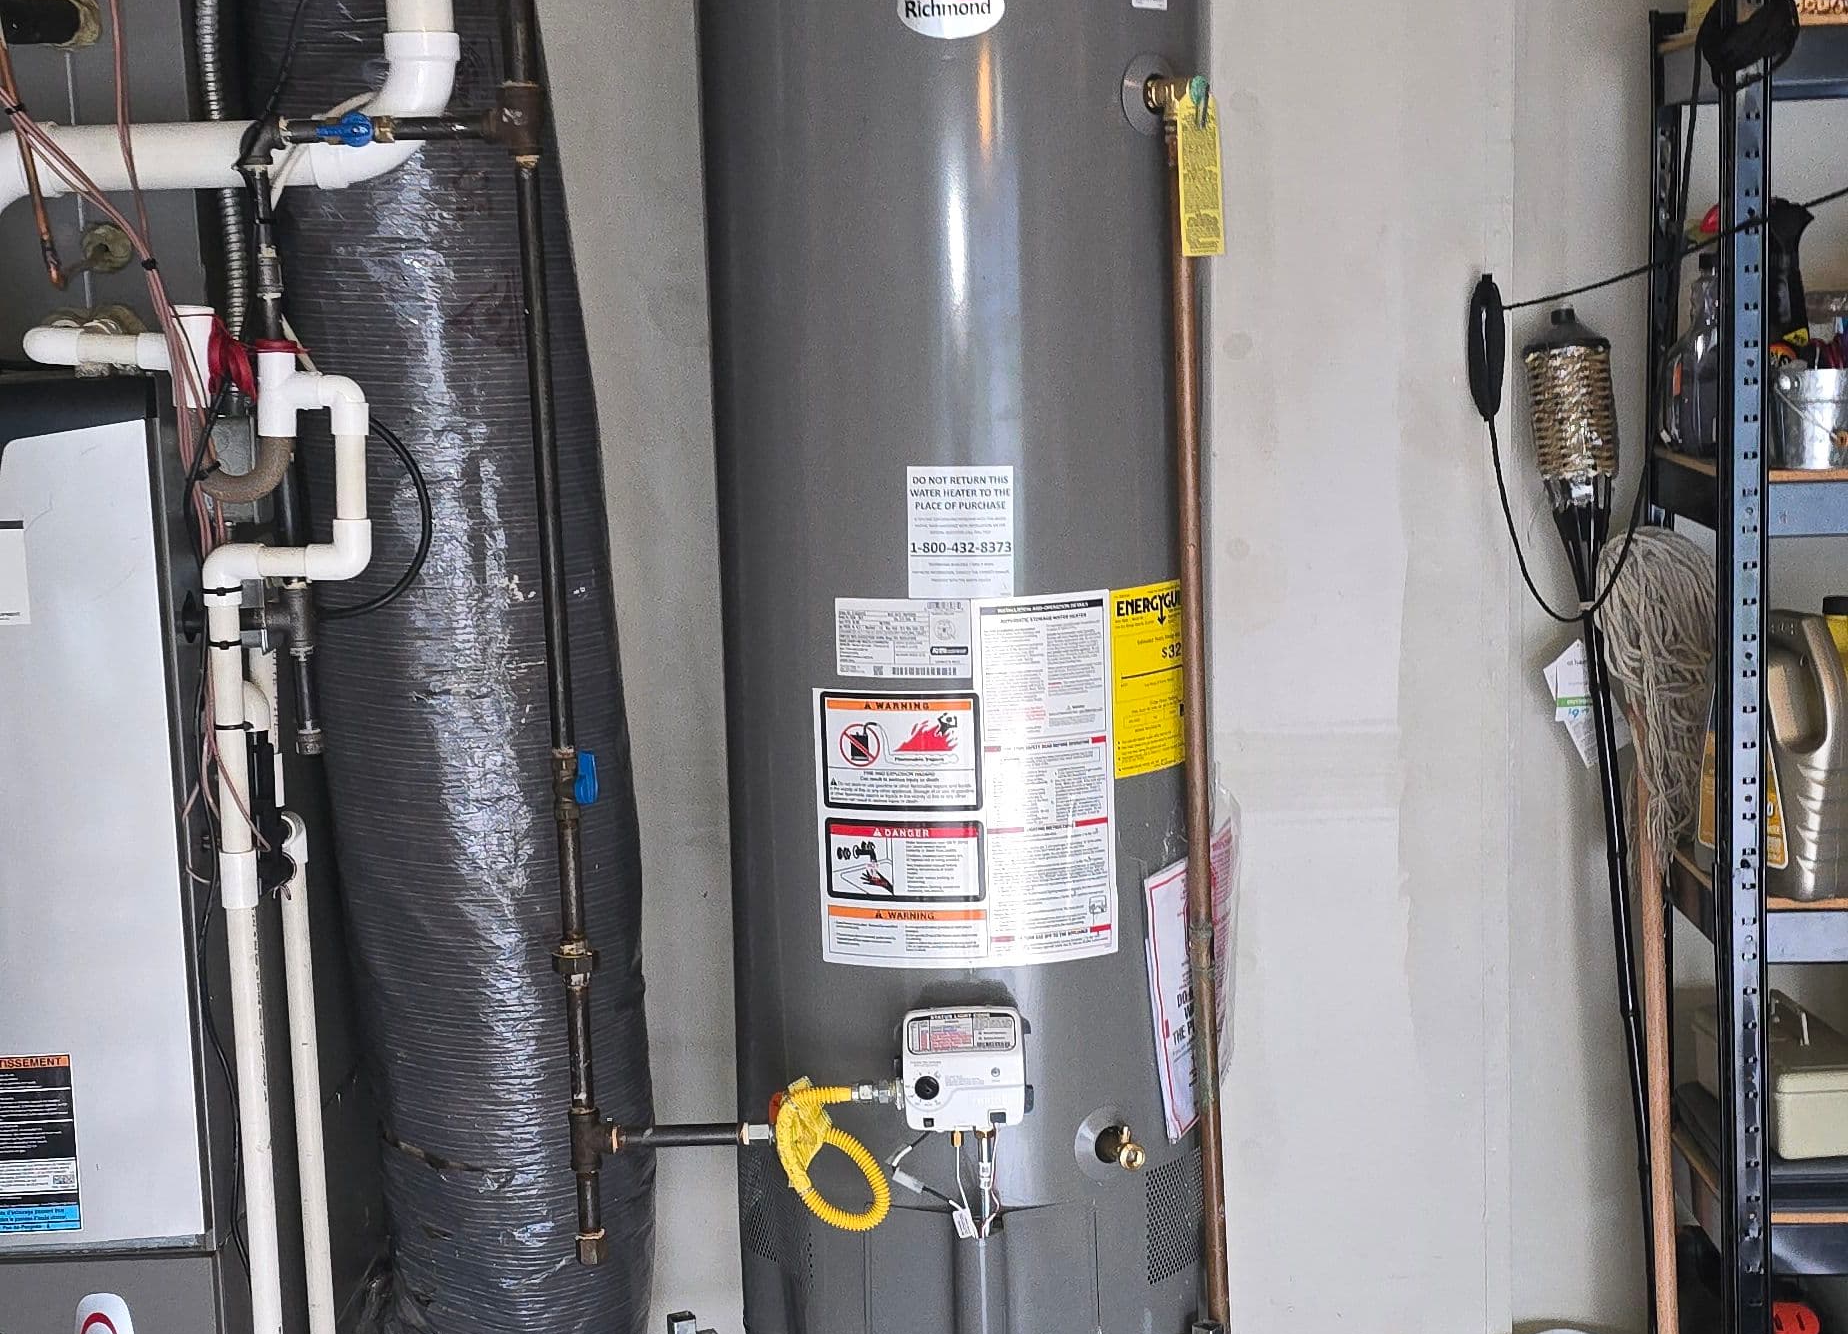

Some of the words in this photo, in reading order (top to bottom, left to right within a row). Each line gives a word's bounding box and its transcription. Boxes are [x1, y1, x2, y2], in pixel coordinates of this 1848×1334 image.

[912, 476, 926, 485] DO
[929, 476, 947, 485] NOT
[950, 476, 986, 484] RETURN
[989, 475, 1009, 484] THIS
[910, 489, 941, 497] WATER
[944, 489, 977, 497] HEATER
[980, 489, 992, 497] TO
[994, 488, 1011, 497] THE
[915, 502, 942, 510] PLACE
[944, 502, 957, 510] OF
[959, 501, 1006, 510] PURCHASE
[910, 541, 1012, 554] 1-800-432-8373
[876, 701, 930, 710] WARNING
[884, 829, 930, 838] DANGER
[887, 911, 935, 921] WARNING
[1173, 1024, 1186, 1045] THE
